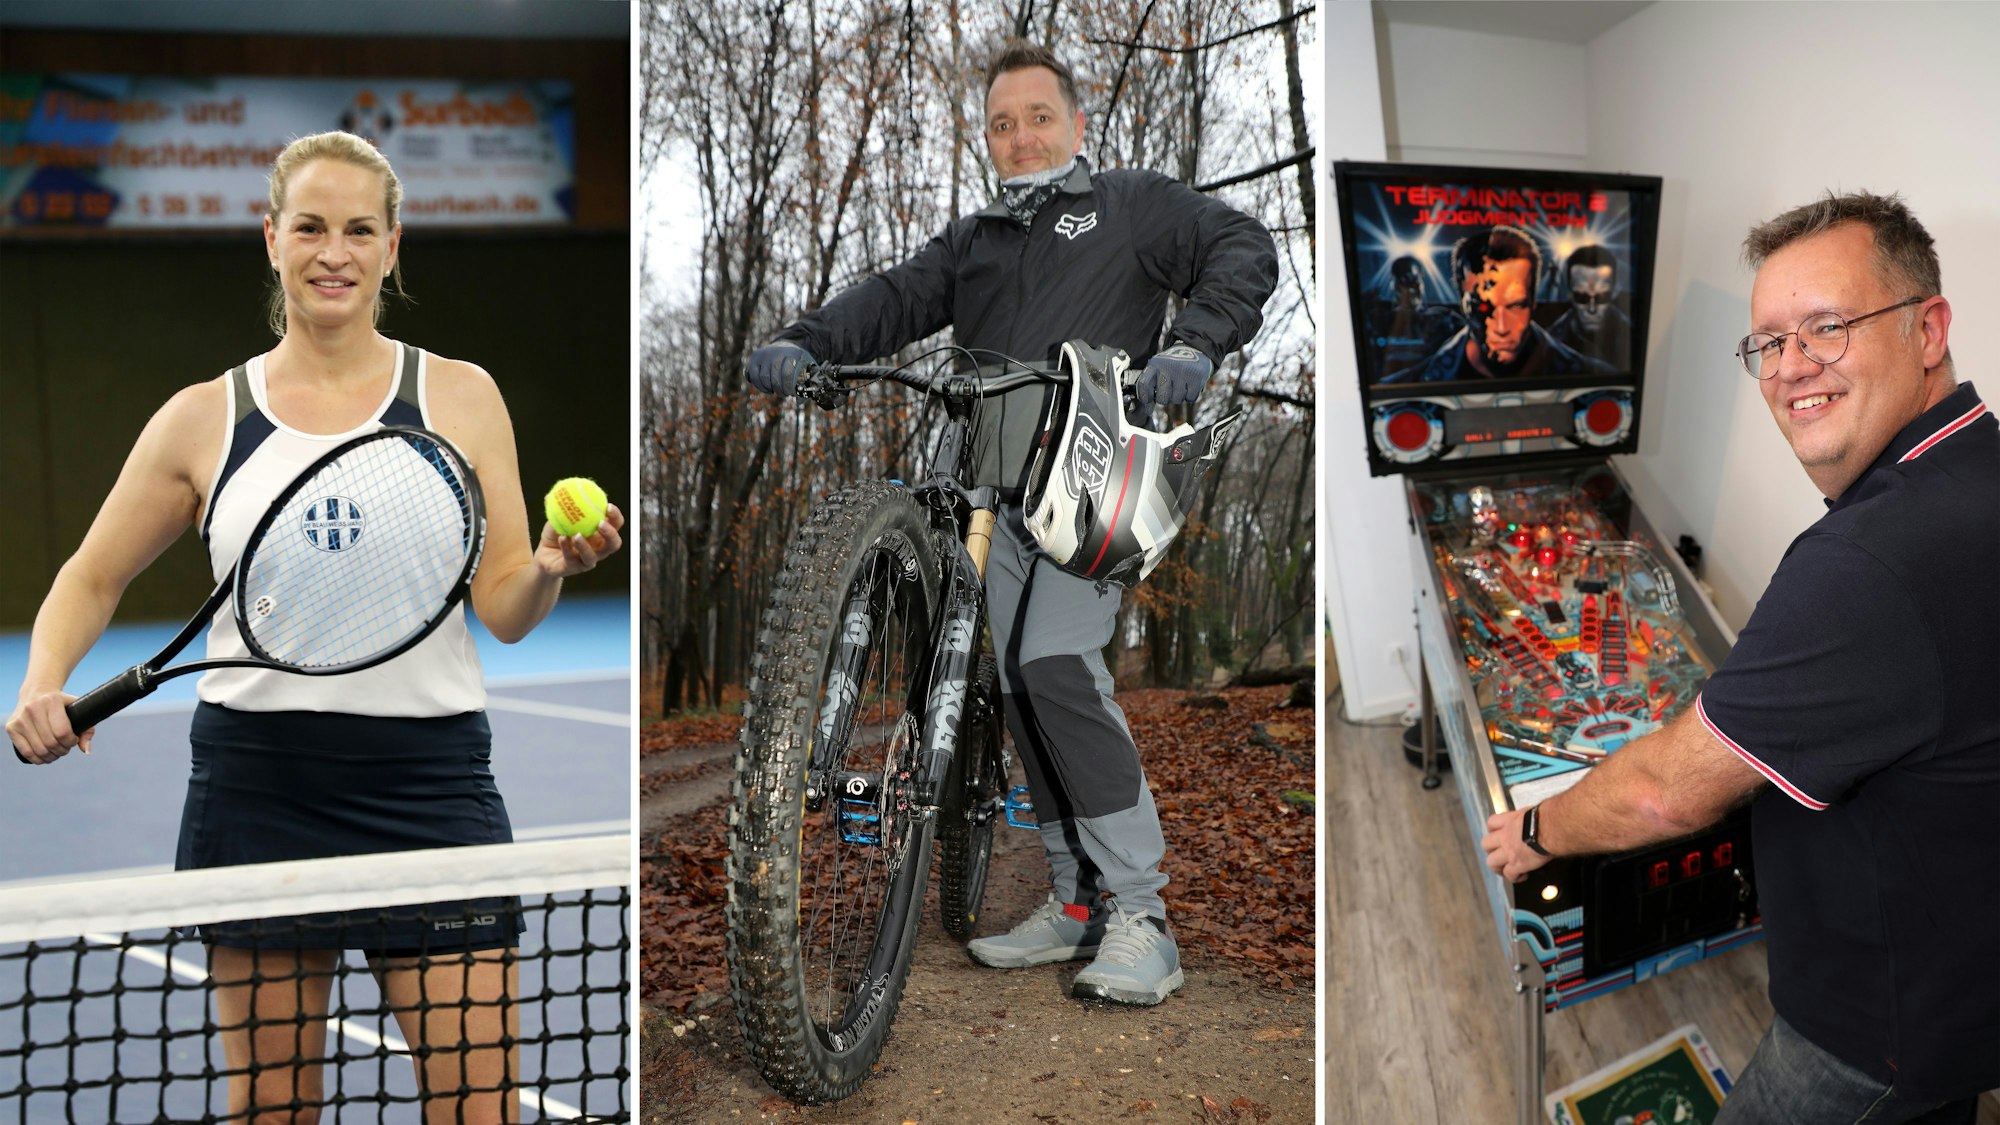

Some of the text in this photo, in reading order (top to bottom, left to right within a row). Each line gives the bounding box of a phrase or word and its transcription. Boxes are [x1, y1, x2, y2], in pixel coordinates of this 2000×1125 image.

[1385, 186, 1582, 210] TERMINATOR
[1412, 208, 1537, 226] JUDGMENT
[433, 914, 497, 931] HEAD
